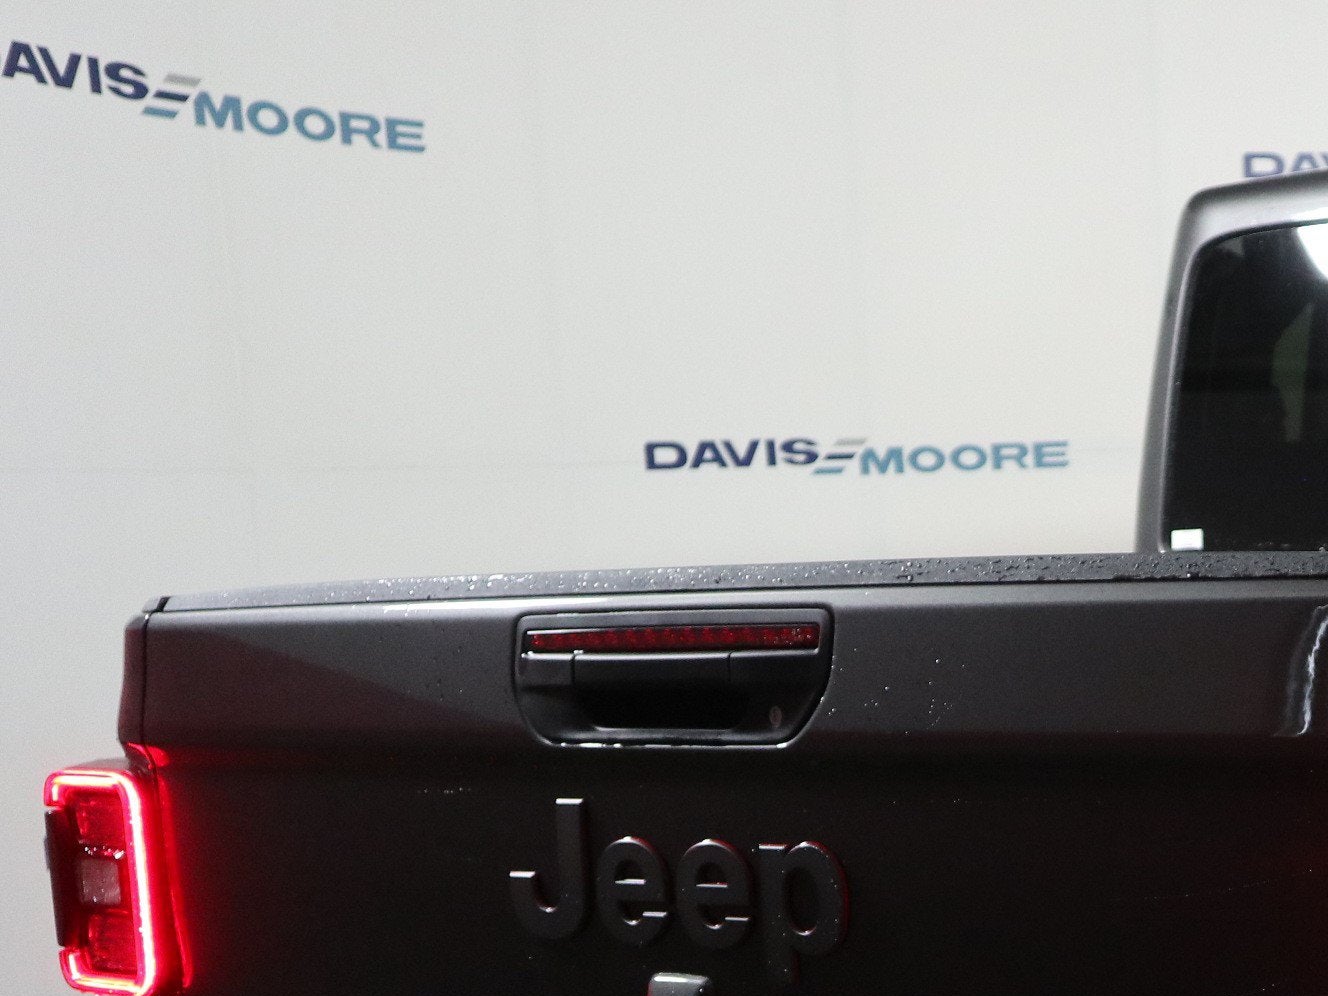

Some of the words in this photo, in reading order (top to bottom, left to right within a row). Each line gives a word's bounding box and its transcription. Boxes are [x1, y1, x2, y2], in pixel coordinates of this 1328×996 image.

[2, 40, 150, 101] AVIS
[193, 91, 426, 153] MOORE
[644, 438, 818, 471] DAVIS
[859, 441, 1070, 475] MOORE
[509, 798, 852, 986] Jeep
